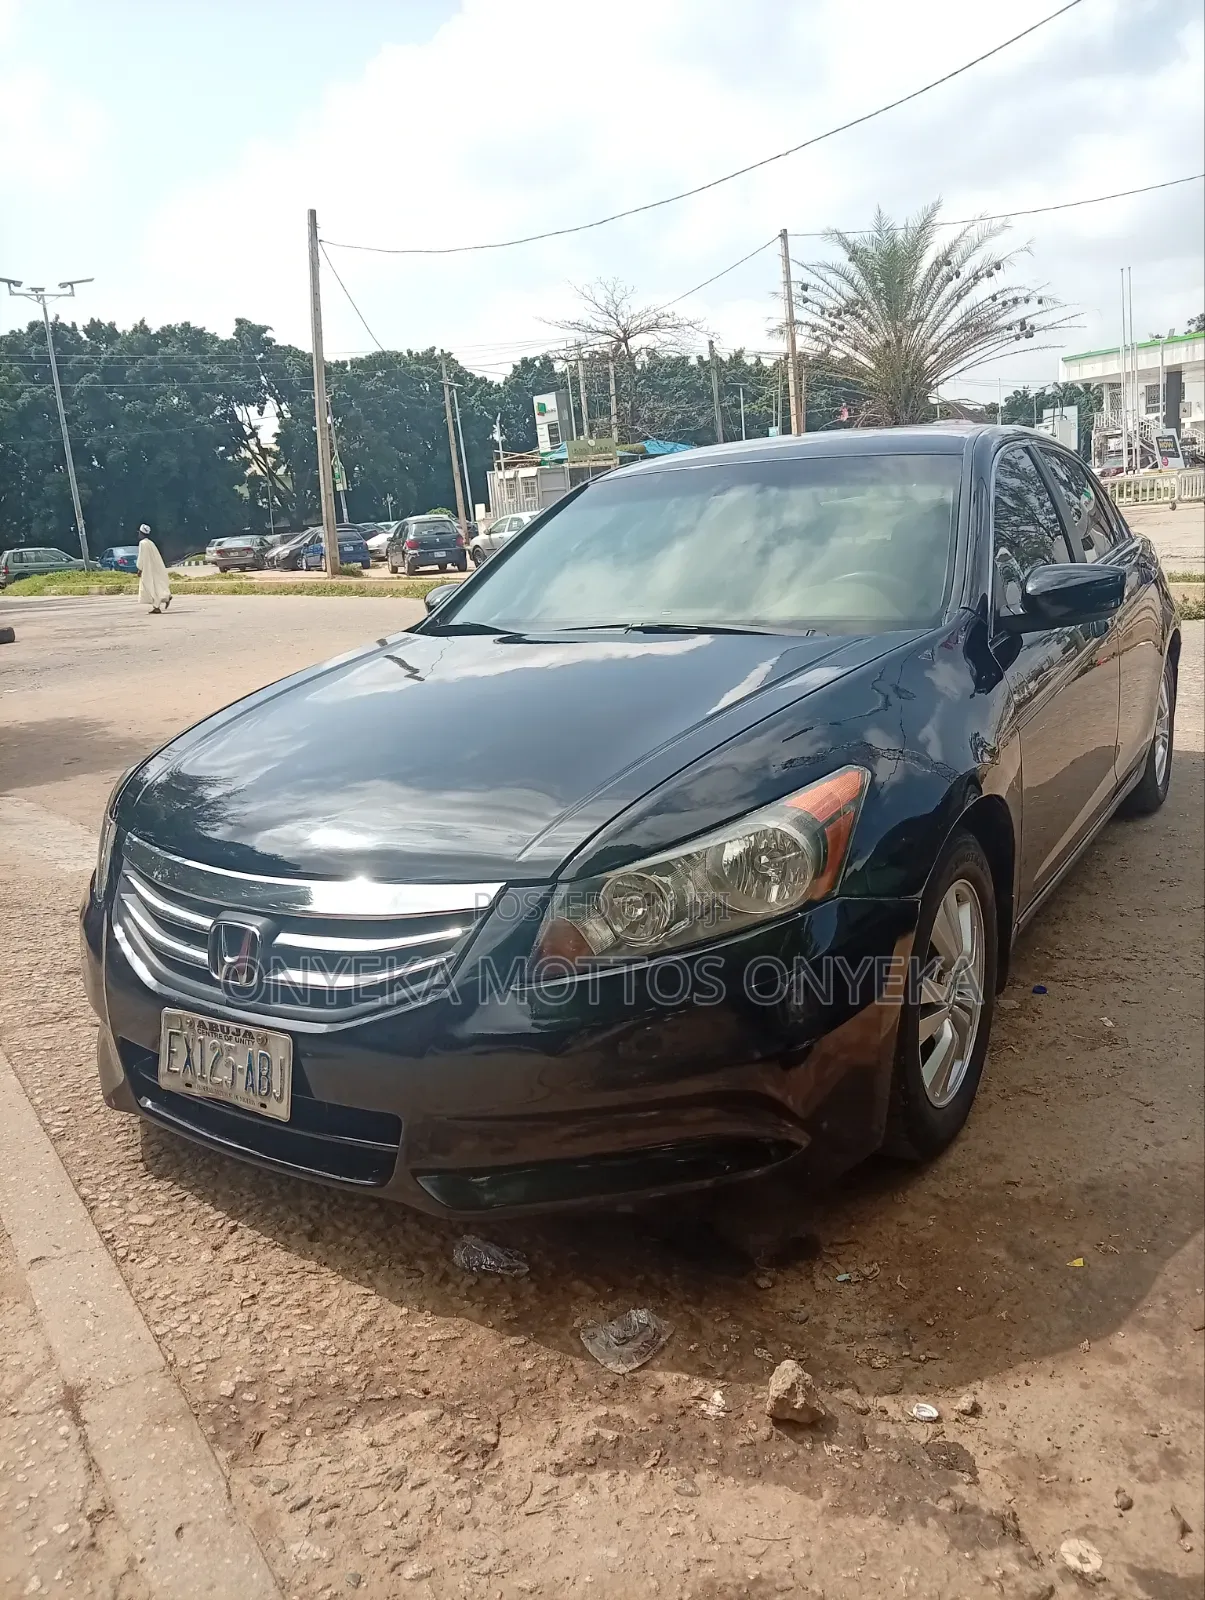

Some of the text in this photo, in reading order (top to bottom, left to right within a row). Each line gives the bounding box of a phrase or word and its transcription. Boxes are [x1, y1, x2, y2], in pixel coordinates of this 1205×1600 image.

[197, 1020, 255, 1040] ABUJA
[197, 1029, 255, 1046] CENTRE OF UNITY
